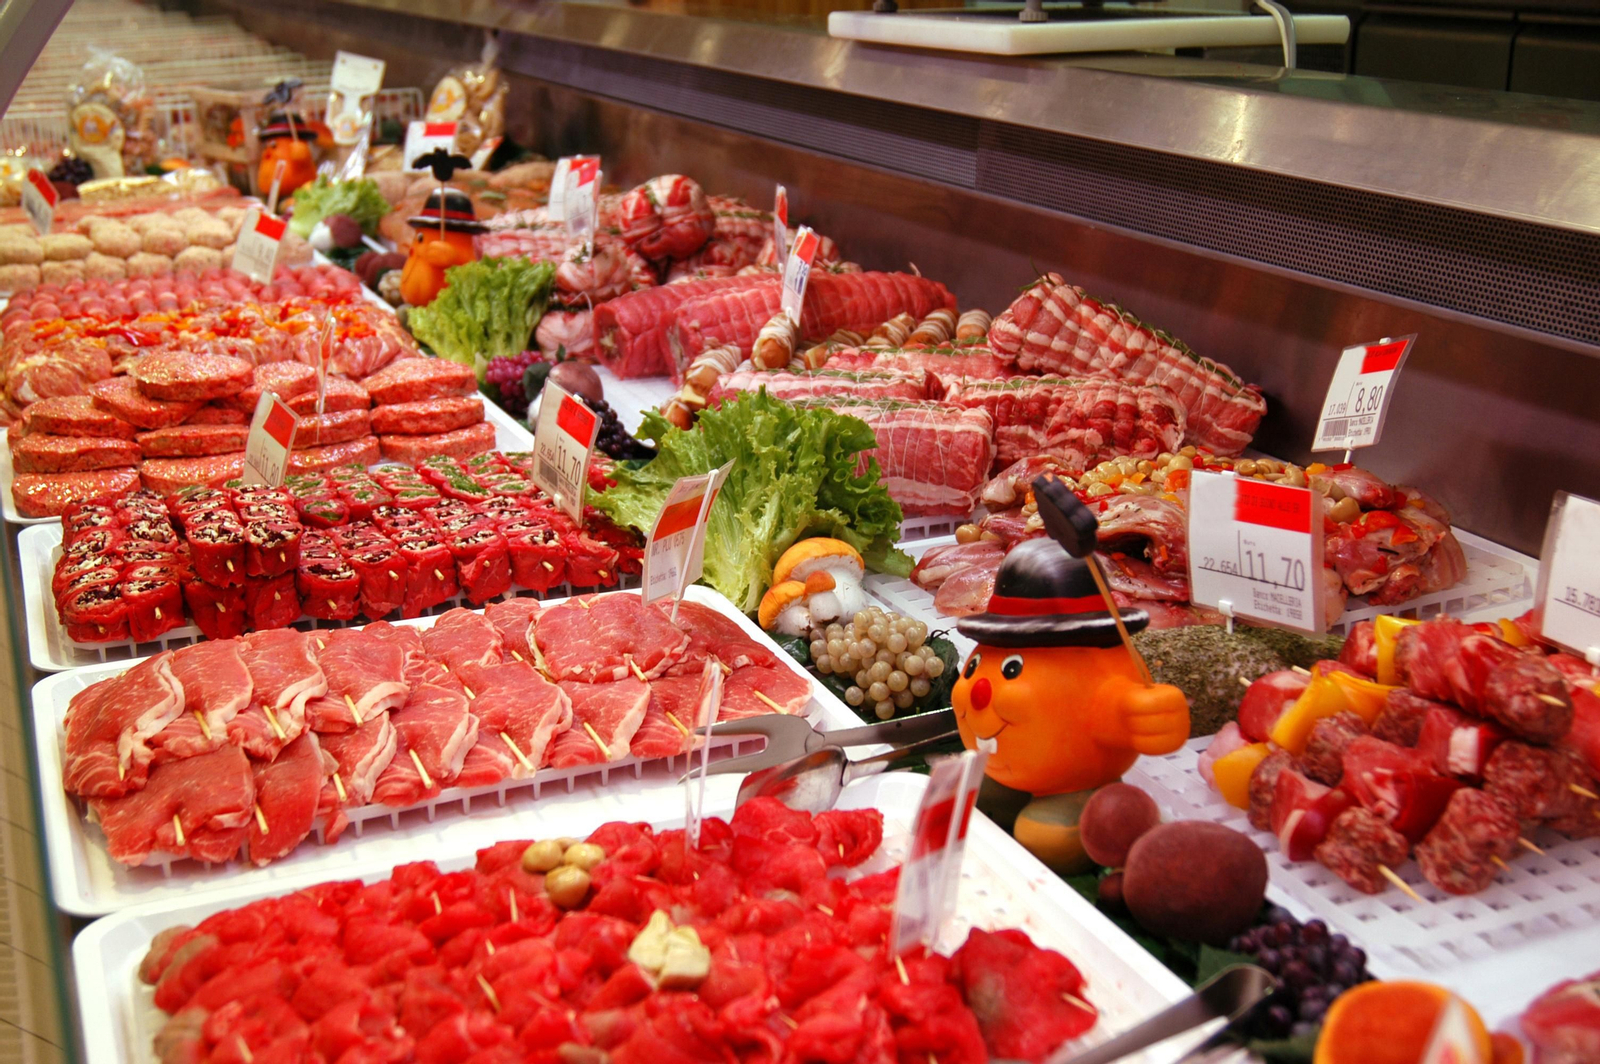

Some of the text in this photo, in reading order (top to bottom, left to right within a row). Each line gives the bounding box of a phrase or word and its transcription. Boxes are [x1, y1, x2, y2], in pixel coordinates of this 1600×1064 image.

[1355, 385, 1383, 415] 8,80
[557, 445, 582, 486] 11,70
[1203, 550, 1305, 592] 22.654 11,70
